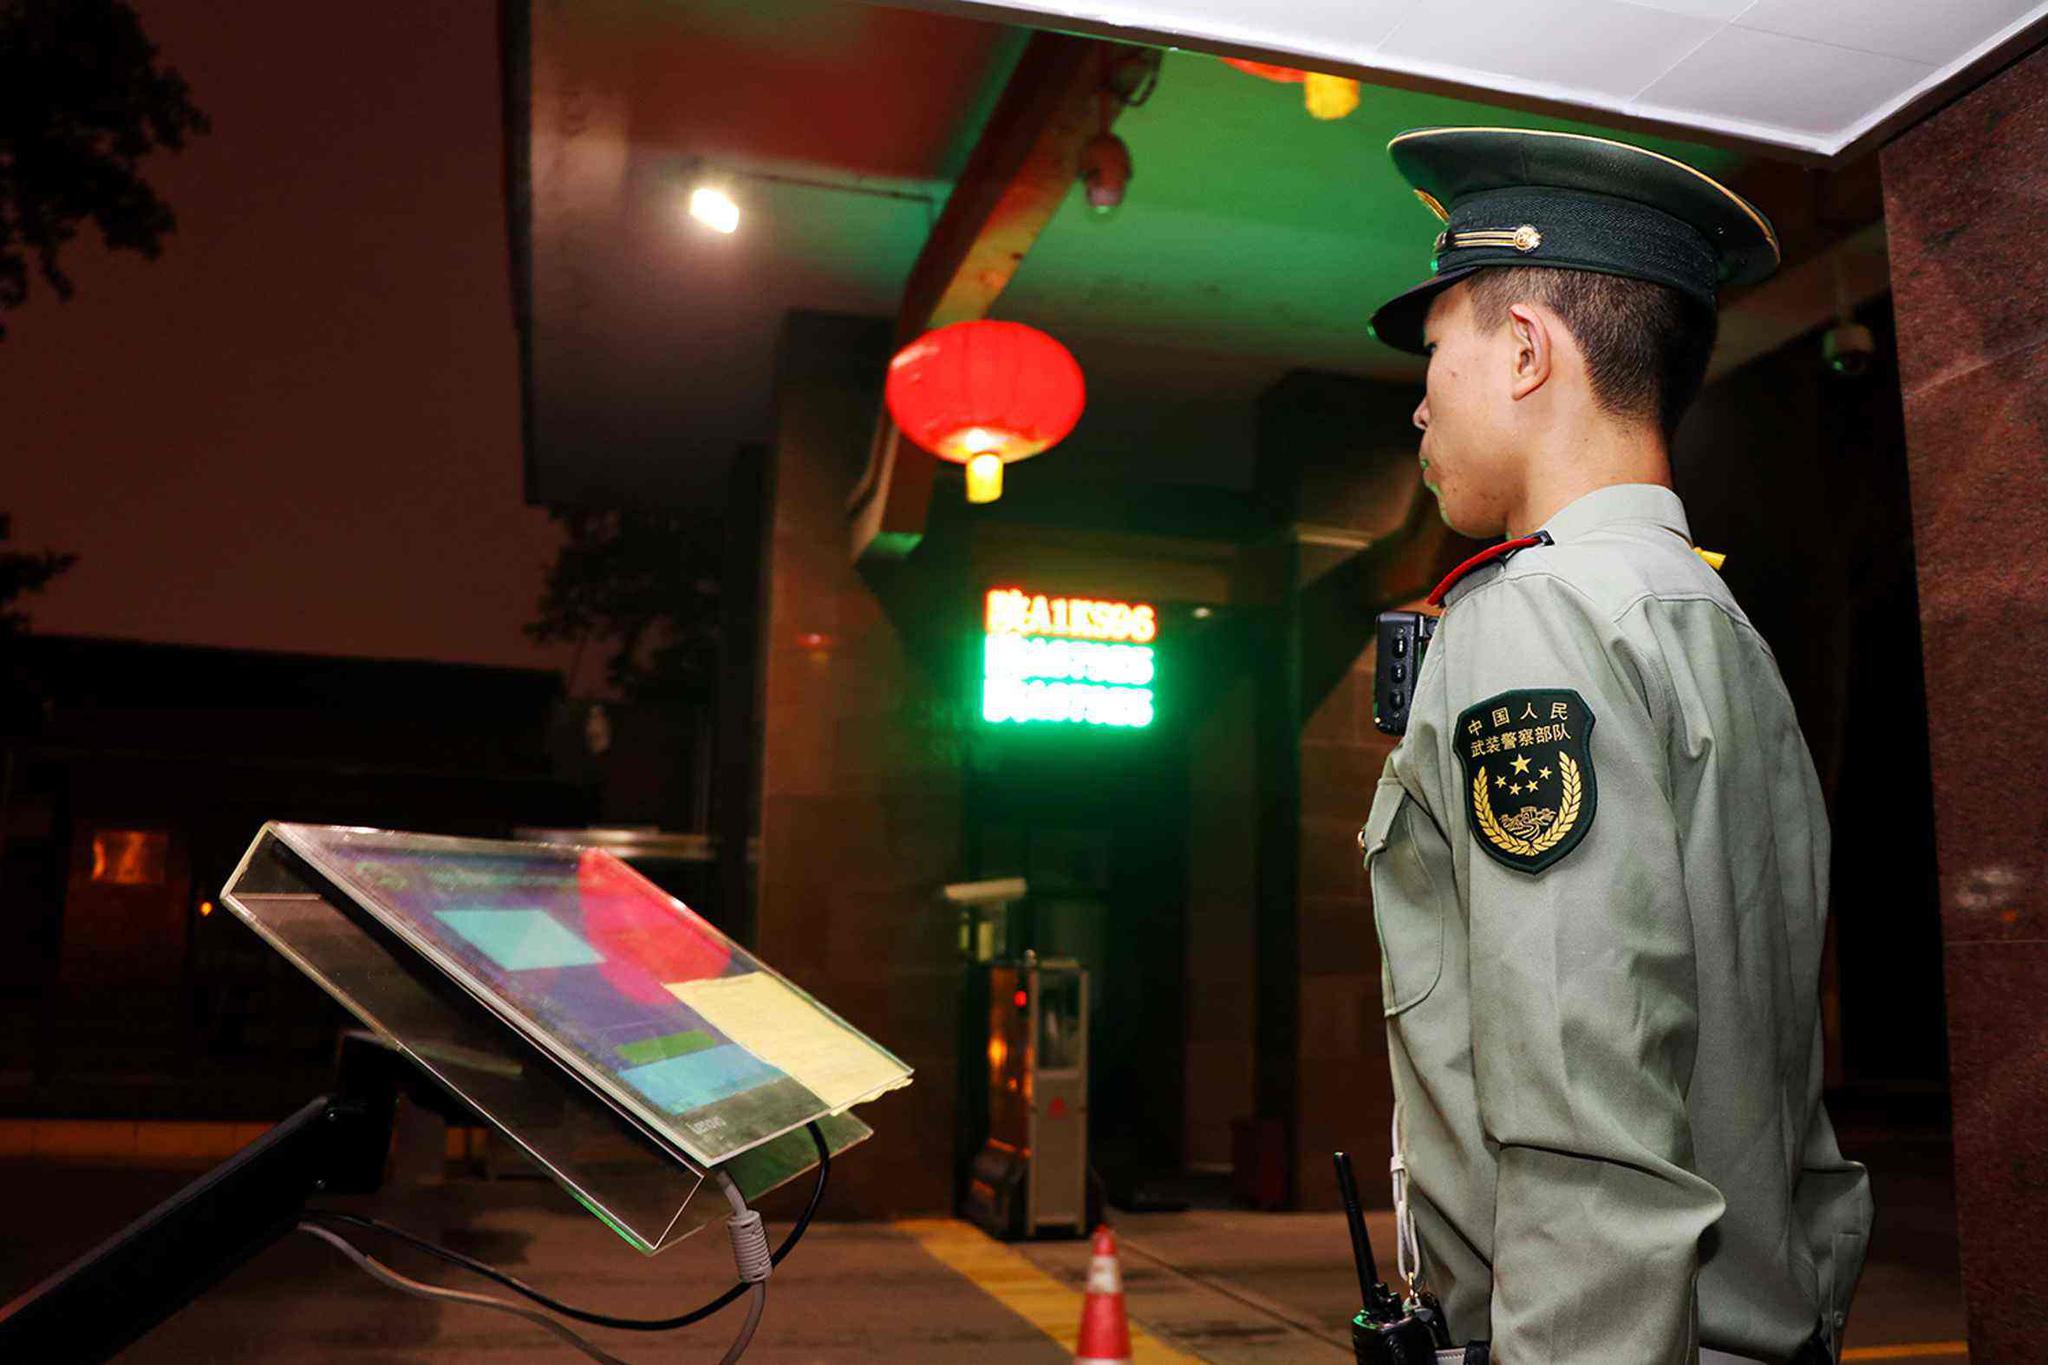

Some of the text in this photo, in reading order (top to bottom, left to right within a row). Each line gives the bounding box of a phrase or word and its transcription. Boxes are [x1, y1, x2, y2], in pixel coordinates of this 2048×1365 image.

[1467, 702, 1569, 737] 中国人民
[1470, 723, 1572, 758] 武装警察部队
